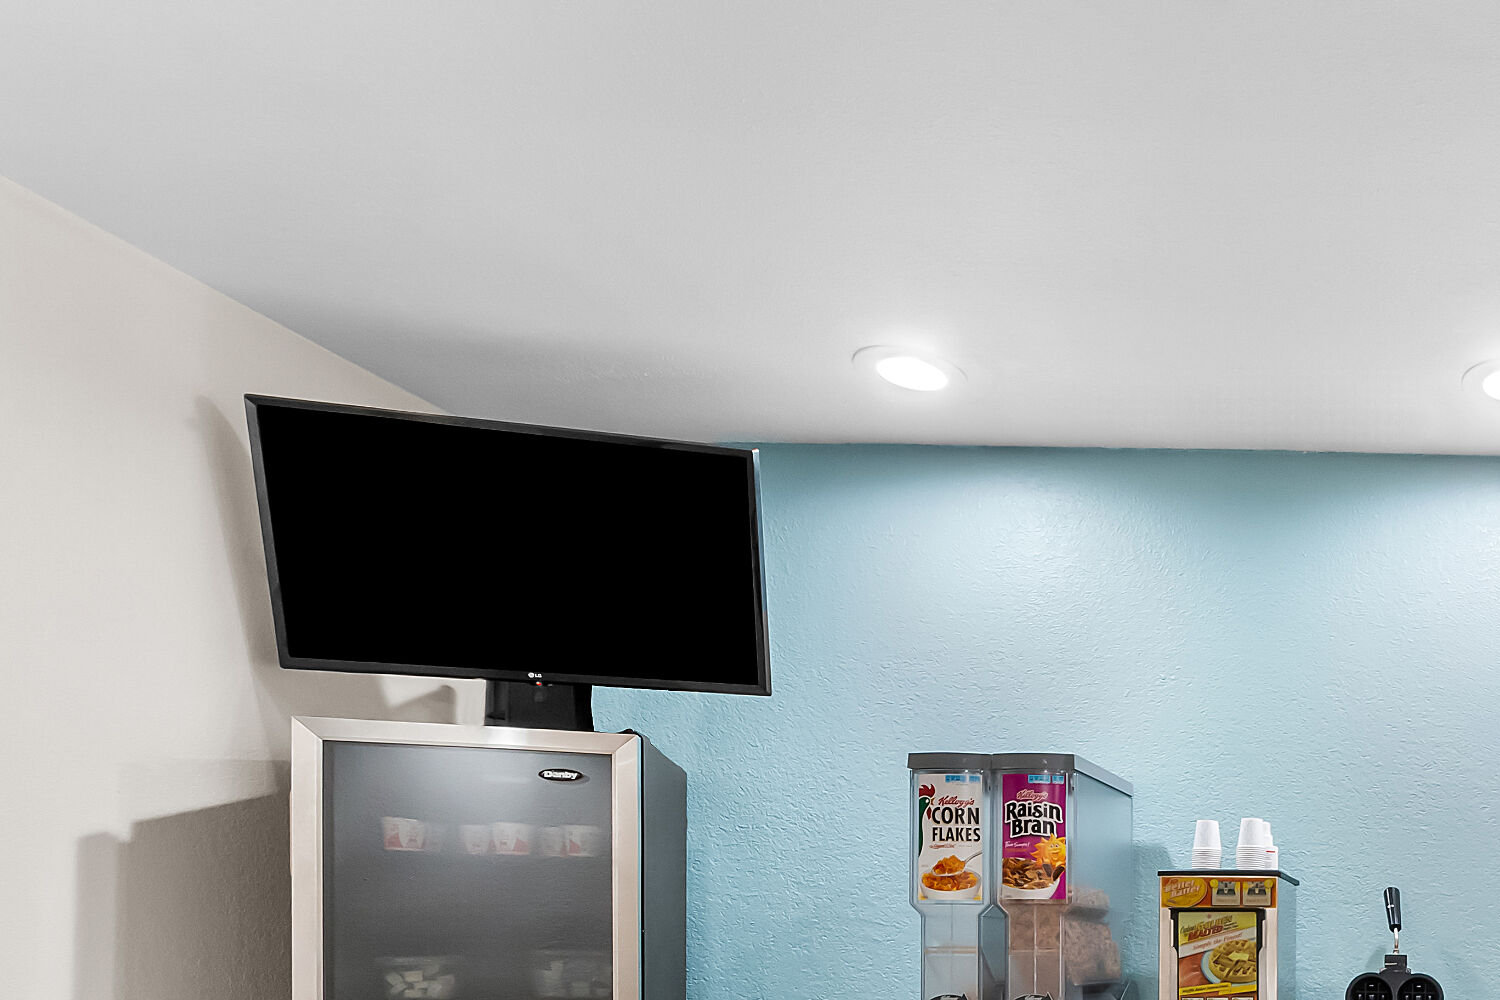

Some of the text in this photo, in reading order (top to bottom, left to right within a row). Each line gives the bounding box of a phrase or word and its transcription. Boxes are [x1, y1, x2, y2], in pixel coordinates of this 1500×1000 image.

[542, 770, 578, 780] Danby
[938, 795, 975, 808] Kellogg's
[1016, 789, 1048, 801] Kellogg's
[932, 806, 980, 825] CORN
[1006, 801, 1062, 822] Raisin
[932, 827, 981, 842] FLAKES
[1011, 818, 1056, 837] Bran
